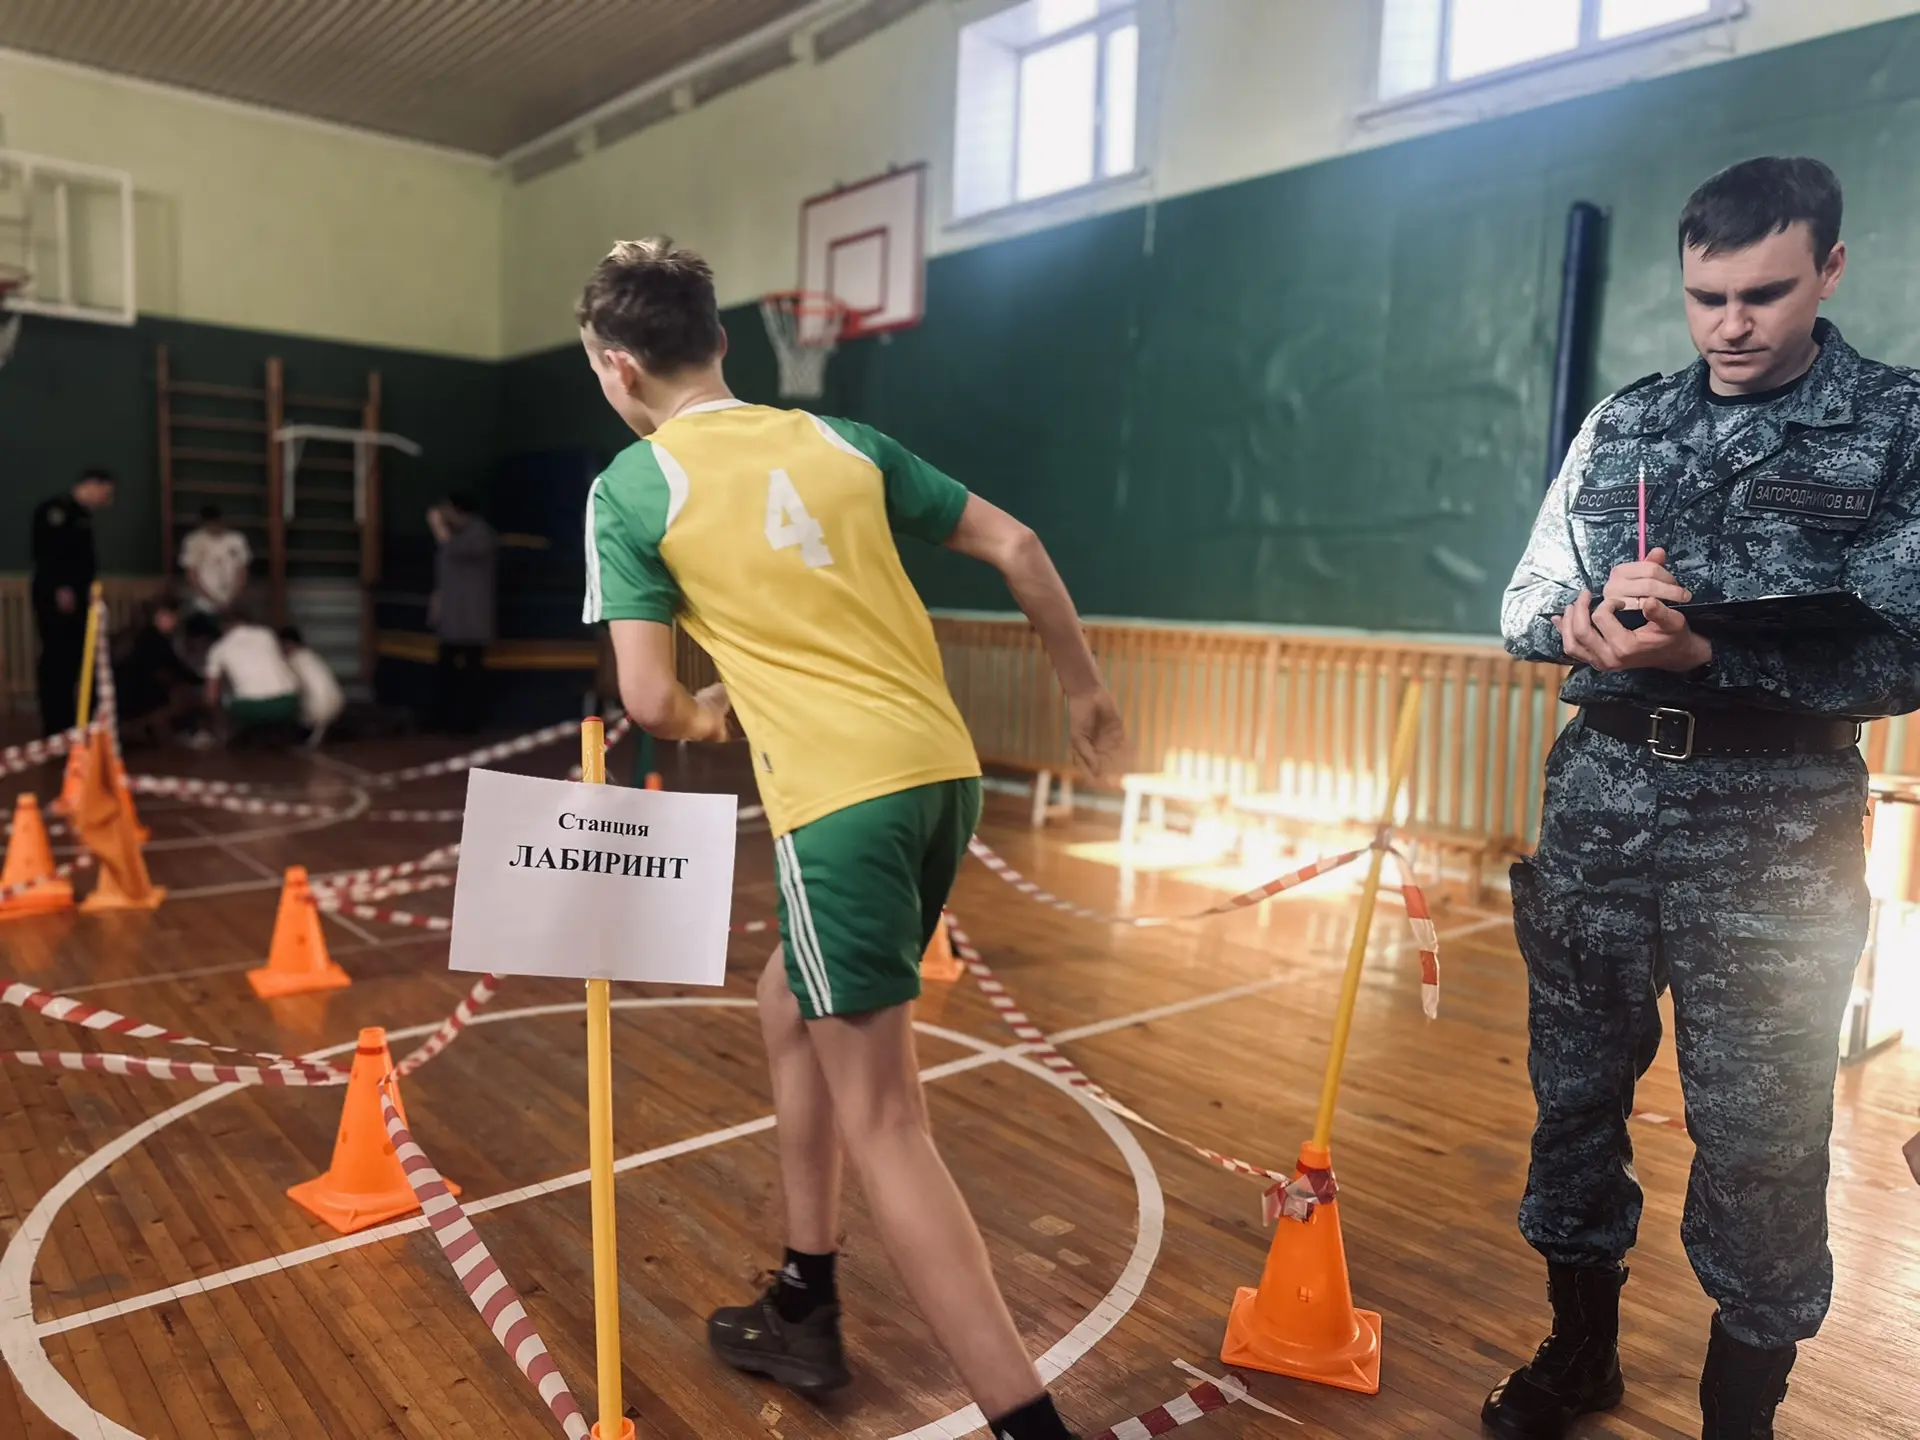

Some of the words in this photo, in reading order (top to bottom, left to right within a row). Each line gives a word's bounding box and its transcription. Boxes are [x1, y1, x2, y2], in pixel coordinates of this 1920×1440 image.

[1755, 485, 1843, 509] ЗАГОРОДНИКОВ
[1844, 495, 1866, 511] В.М.
[764, 468, 834, 568] 4
[558, 812, 649, 837] Станция
[509, 845, 688, 879] ЛАБИРИНТ
